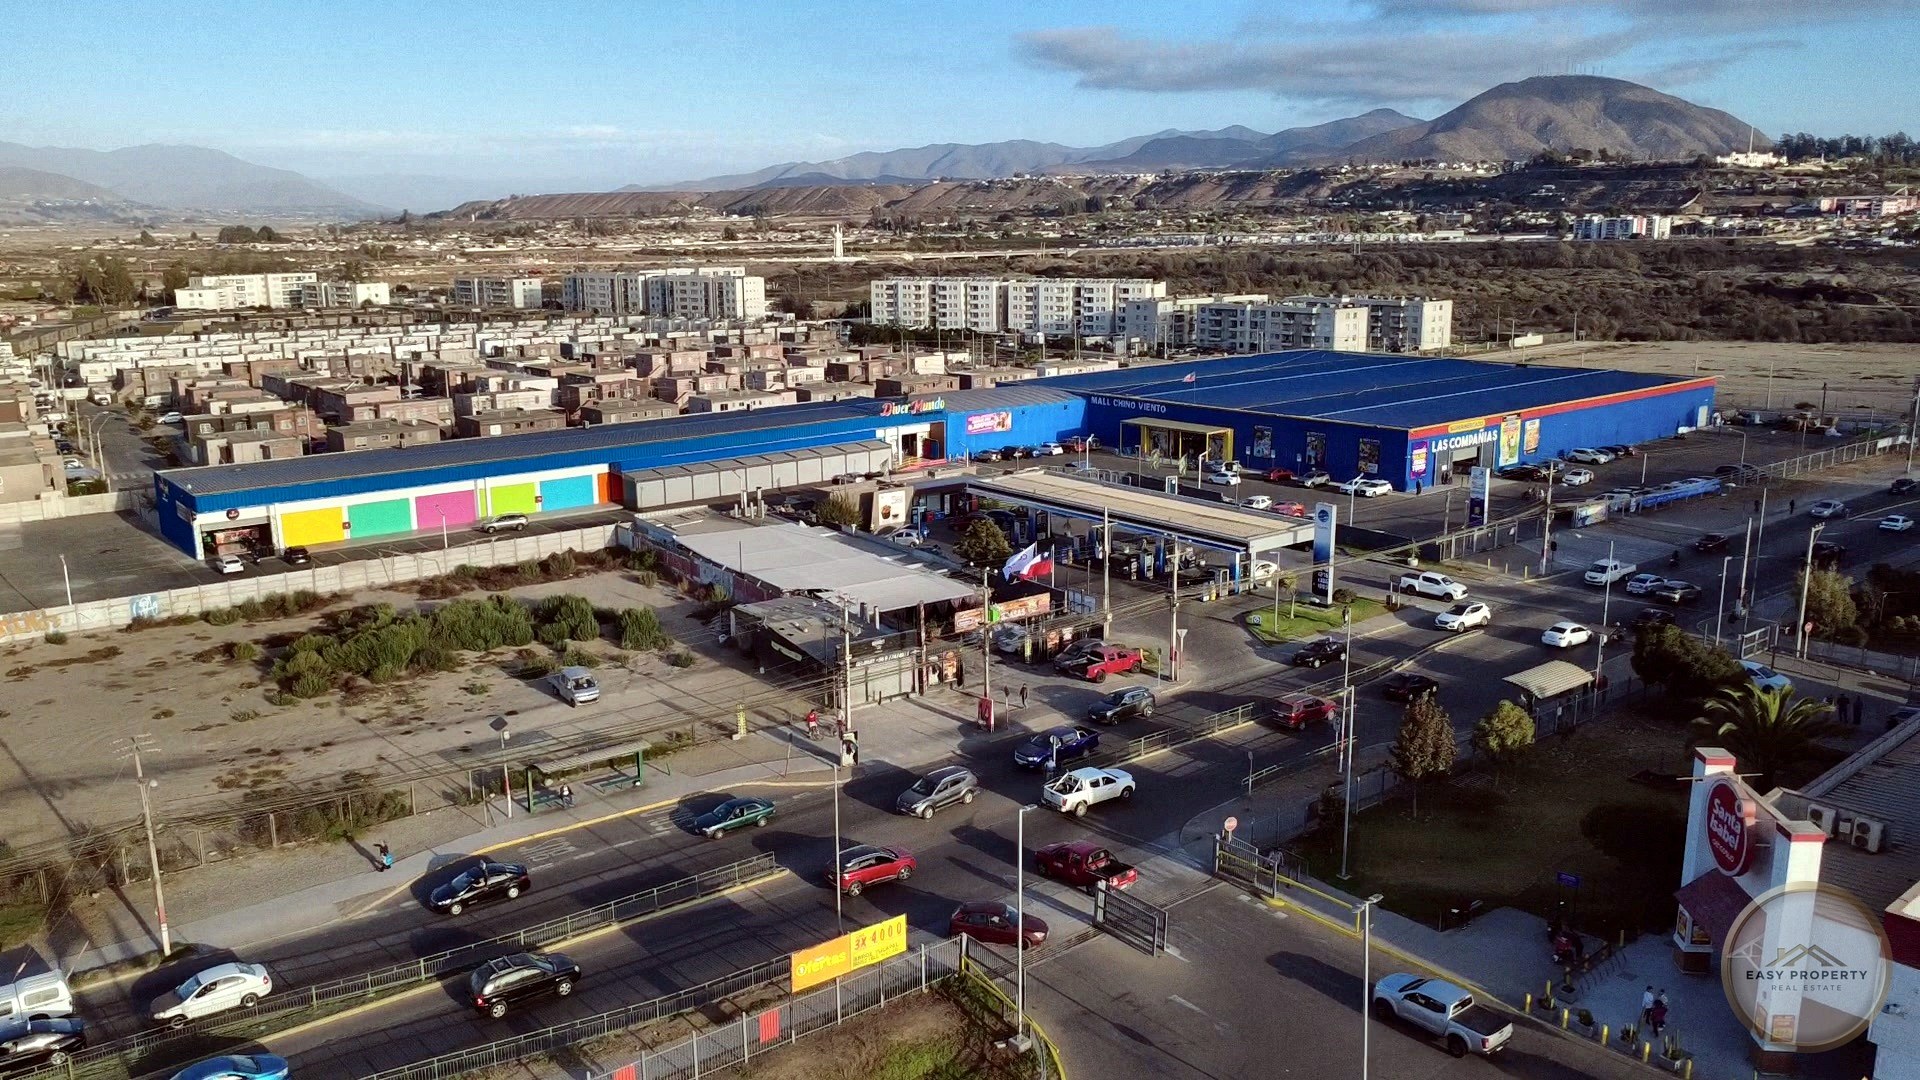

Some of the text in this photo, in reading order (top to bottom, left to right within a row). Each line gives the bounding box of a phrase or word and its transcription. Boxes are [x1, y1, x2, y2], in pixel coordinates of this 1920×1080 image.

[880, 396, 945, 417] Diver Mundo
[1091, 396, 1167, 413] MALL CHINO VIENTO
[1431, 429, 1498, 453] LAS COMPAÑIAS
[1713, 798, 1741, 833] Santa
[1710, 813, 1740, 851] Isabel
[796, 951, 848, 977] Ofertas
